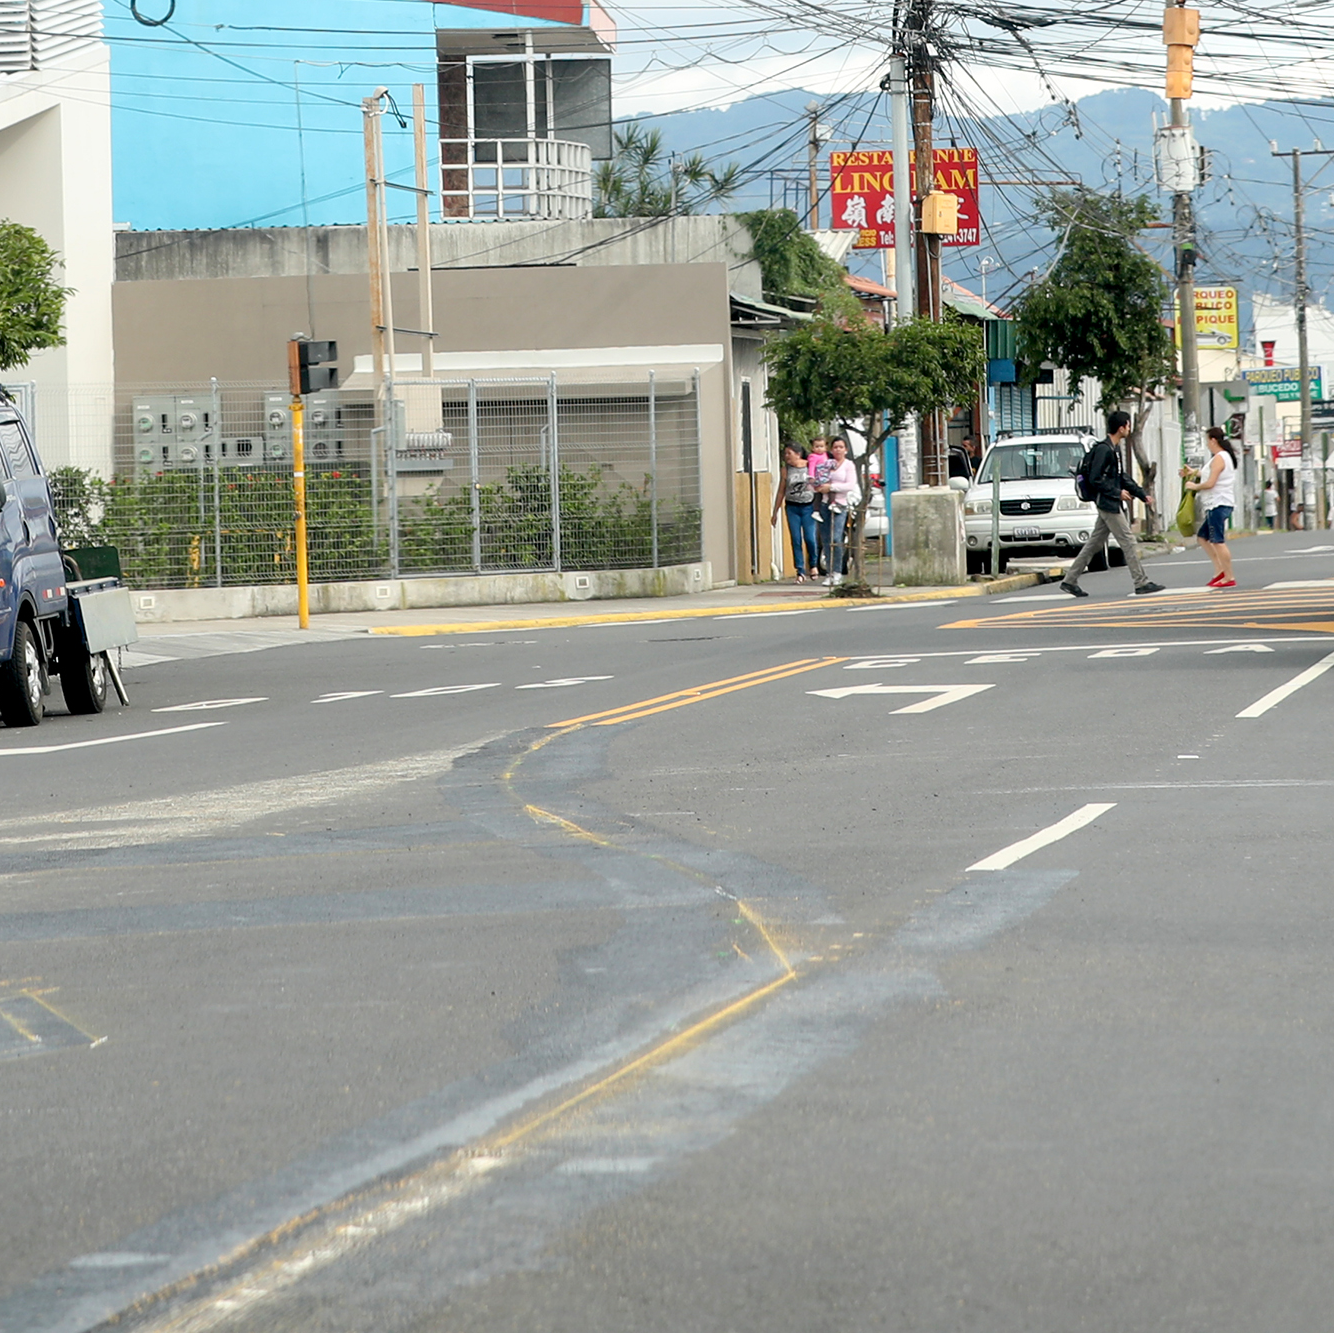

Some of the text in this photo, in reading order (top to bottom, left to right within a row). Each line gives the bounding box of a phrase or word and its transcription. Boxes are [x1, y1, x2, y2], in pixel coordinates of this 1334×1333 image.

[832, 148, 975, 166] RESTANTE
[1196, 315, 1235, 325] PIQUE
[1284, 367, 1319, 381] PUBCO
